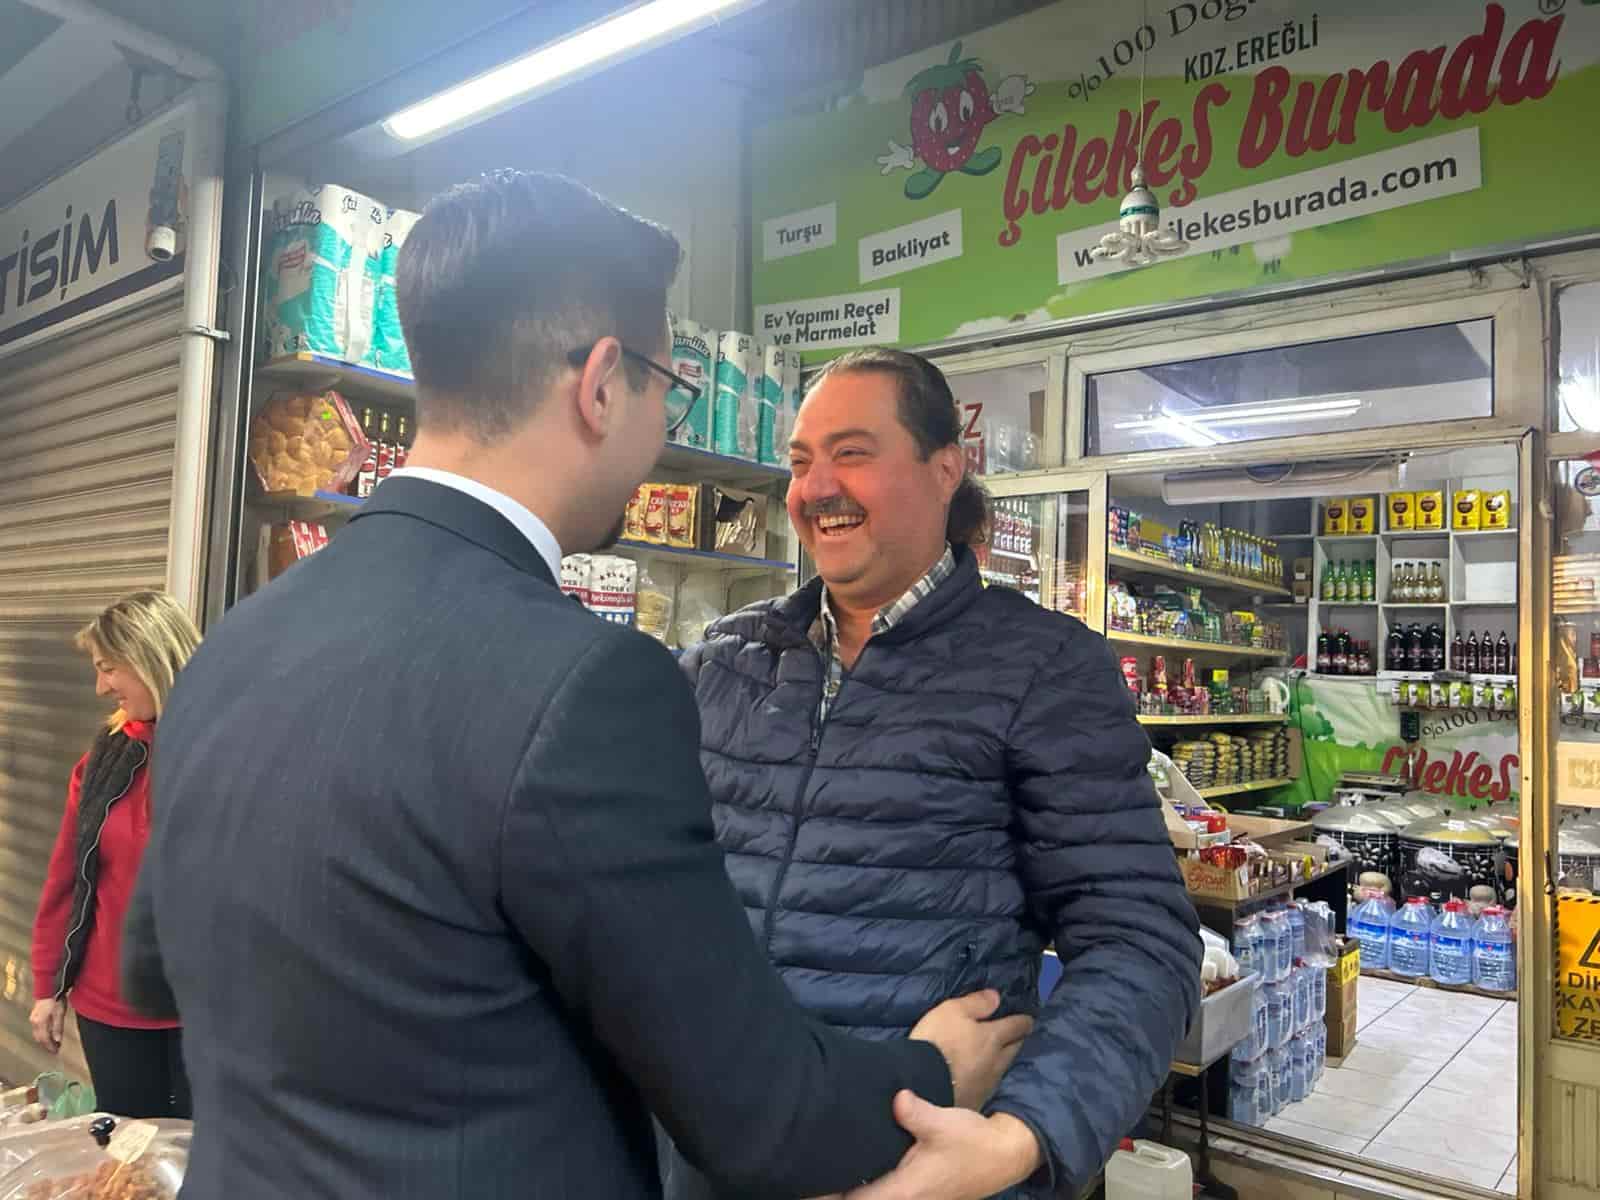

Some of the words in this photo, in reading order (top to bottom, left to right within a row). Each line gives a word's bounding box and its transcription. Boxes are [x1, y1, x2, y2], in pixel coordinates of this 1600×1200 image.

[1067, 24, 1156, 102] %100
[1184, 14, 1319, 84] KDZ.EREĞLİ
[1237, 3, 1565, 169] Burada
[776, 223, 823, 245] Turşu
[871, 230, 951, 267] Bakliyat
[764, 313, 785, 329] Ev
[786, 308, 840, 331] Yapımı
[843, 298, 890, 322] Reçel
[774, 332, 793, 346] ve
[795, 320, 877, 343] Marmelat
